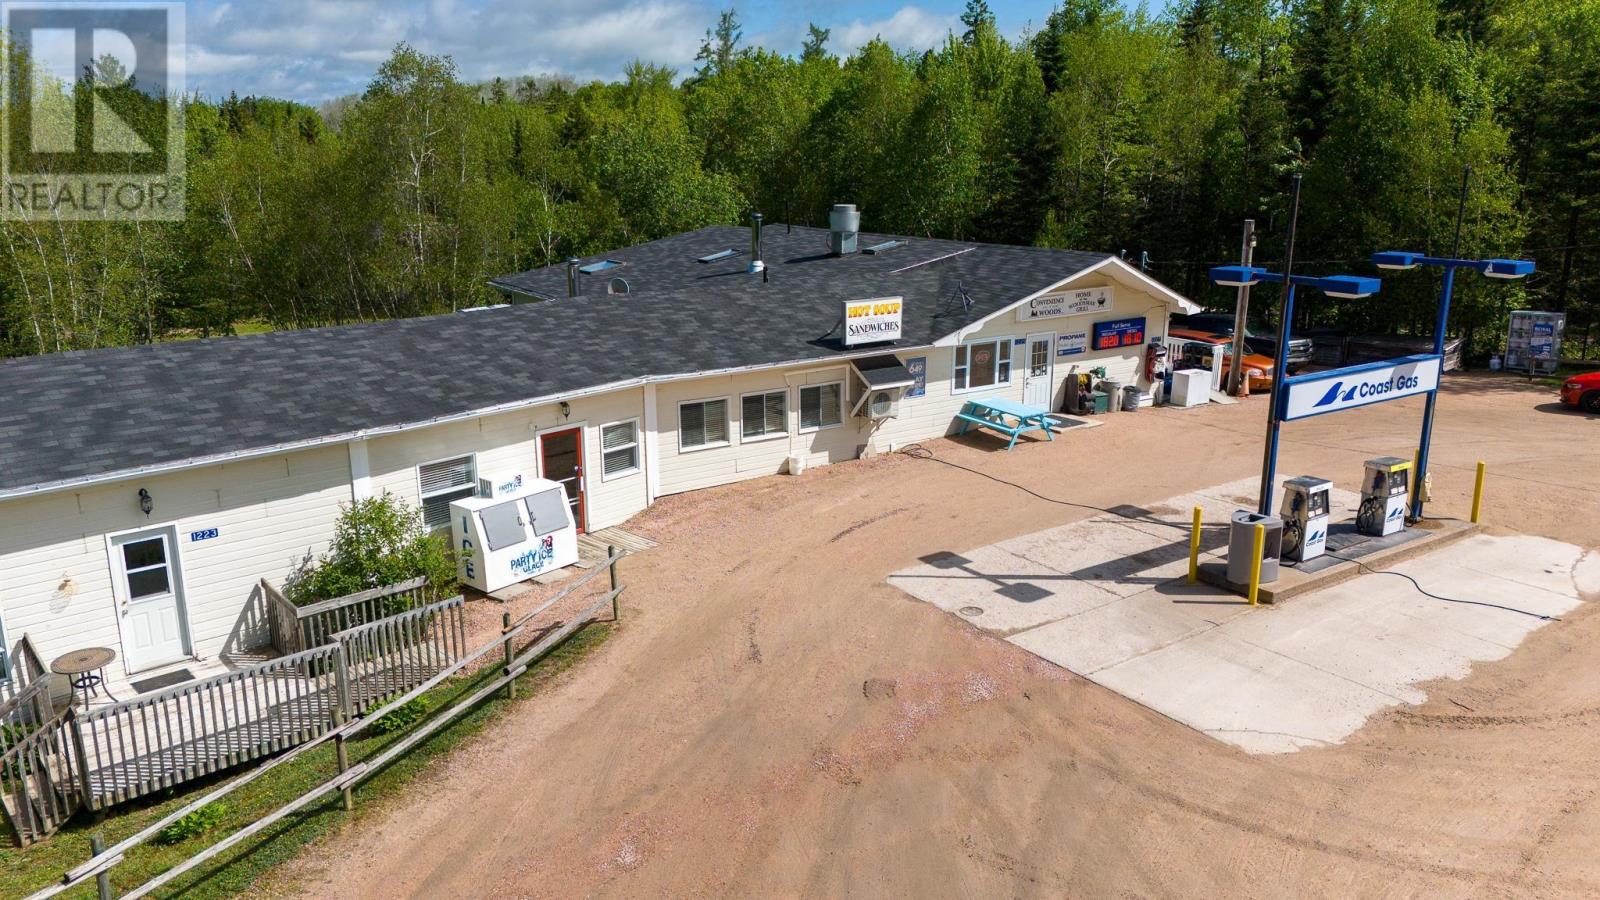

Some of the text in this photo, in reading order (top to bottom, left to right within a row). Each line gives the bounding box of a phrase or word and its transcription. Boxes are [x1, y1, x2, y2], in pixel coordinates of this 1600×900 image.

[848, 302, 901, 319] HOT SOUP
[848, 321, 900, 337] SANDWICHES
[1059, 333, 1086, 341] PROPANE
[1359, 375, 1418, 398] Coast Gas
[193, 529, 217, 541] 1223
[510, 551, 537, 570] PARTY
